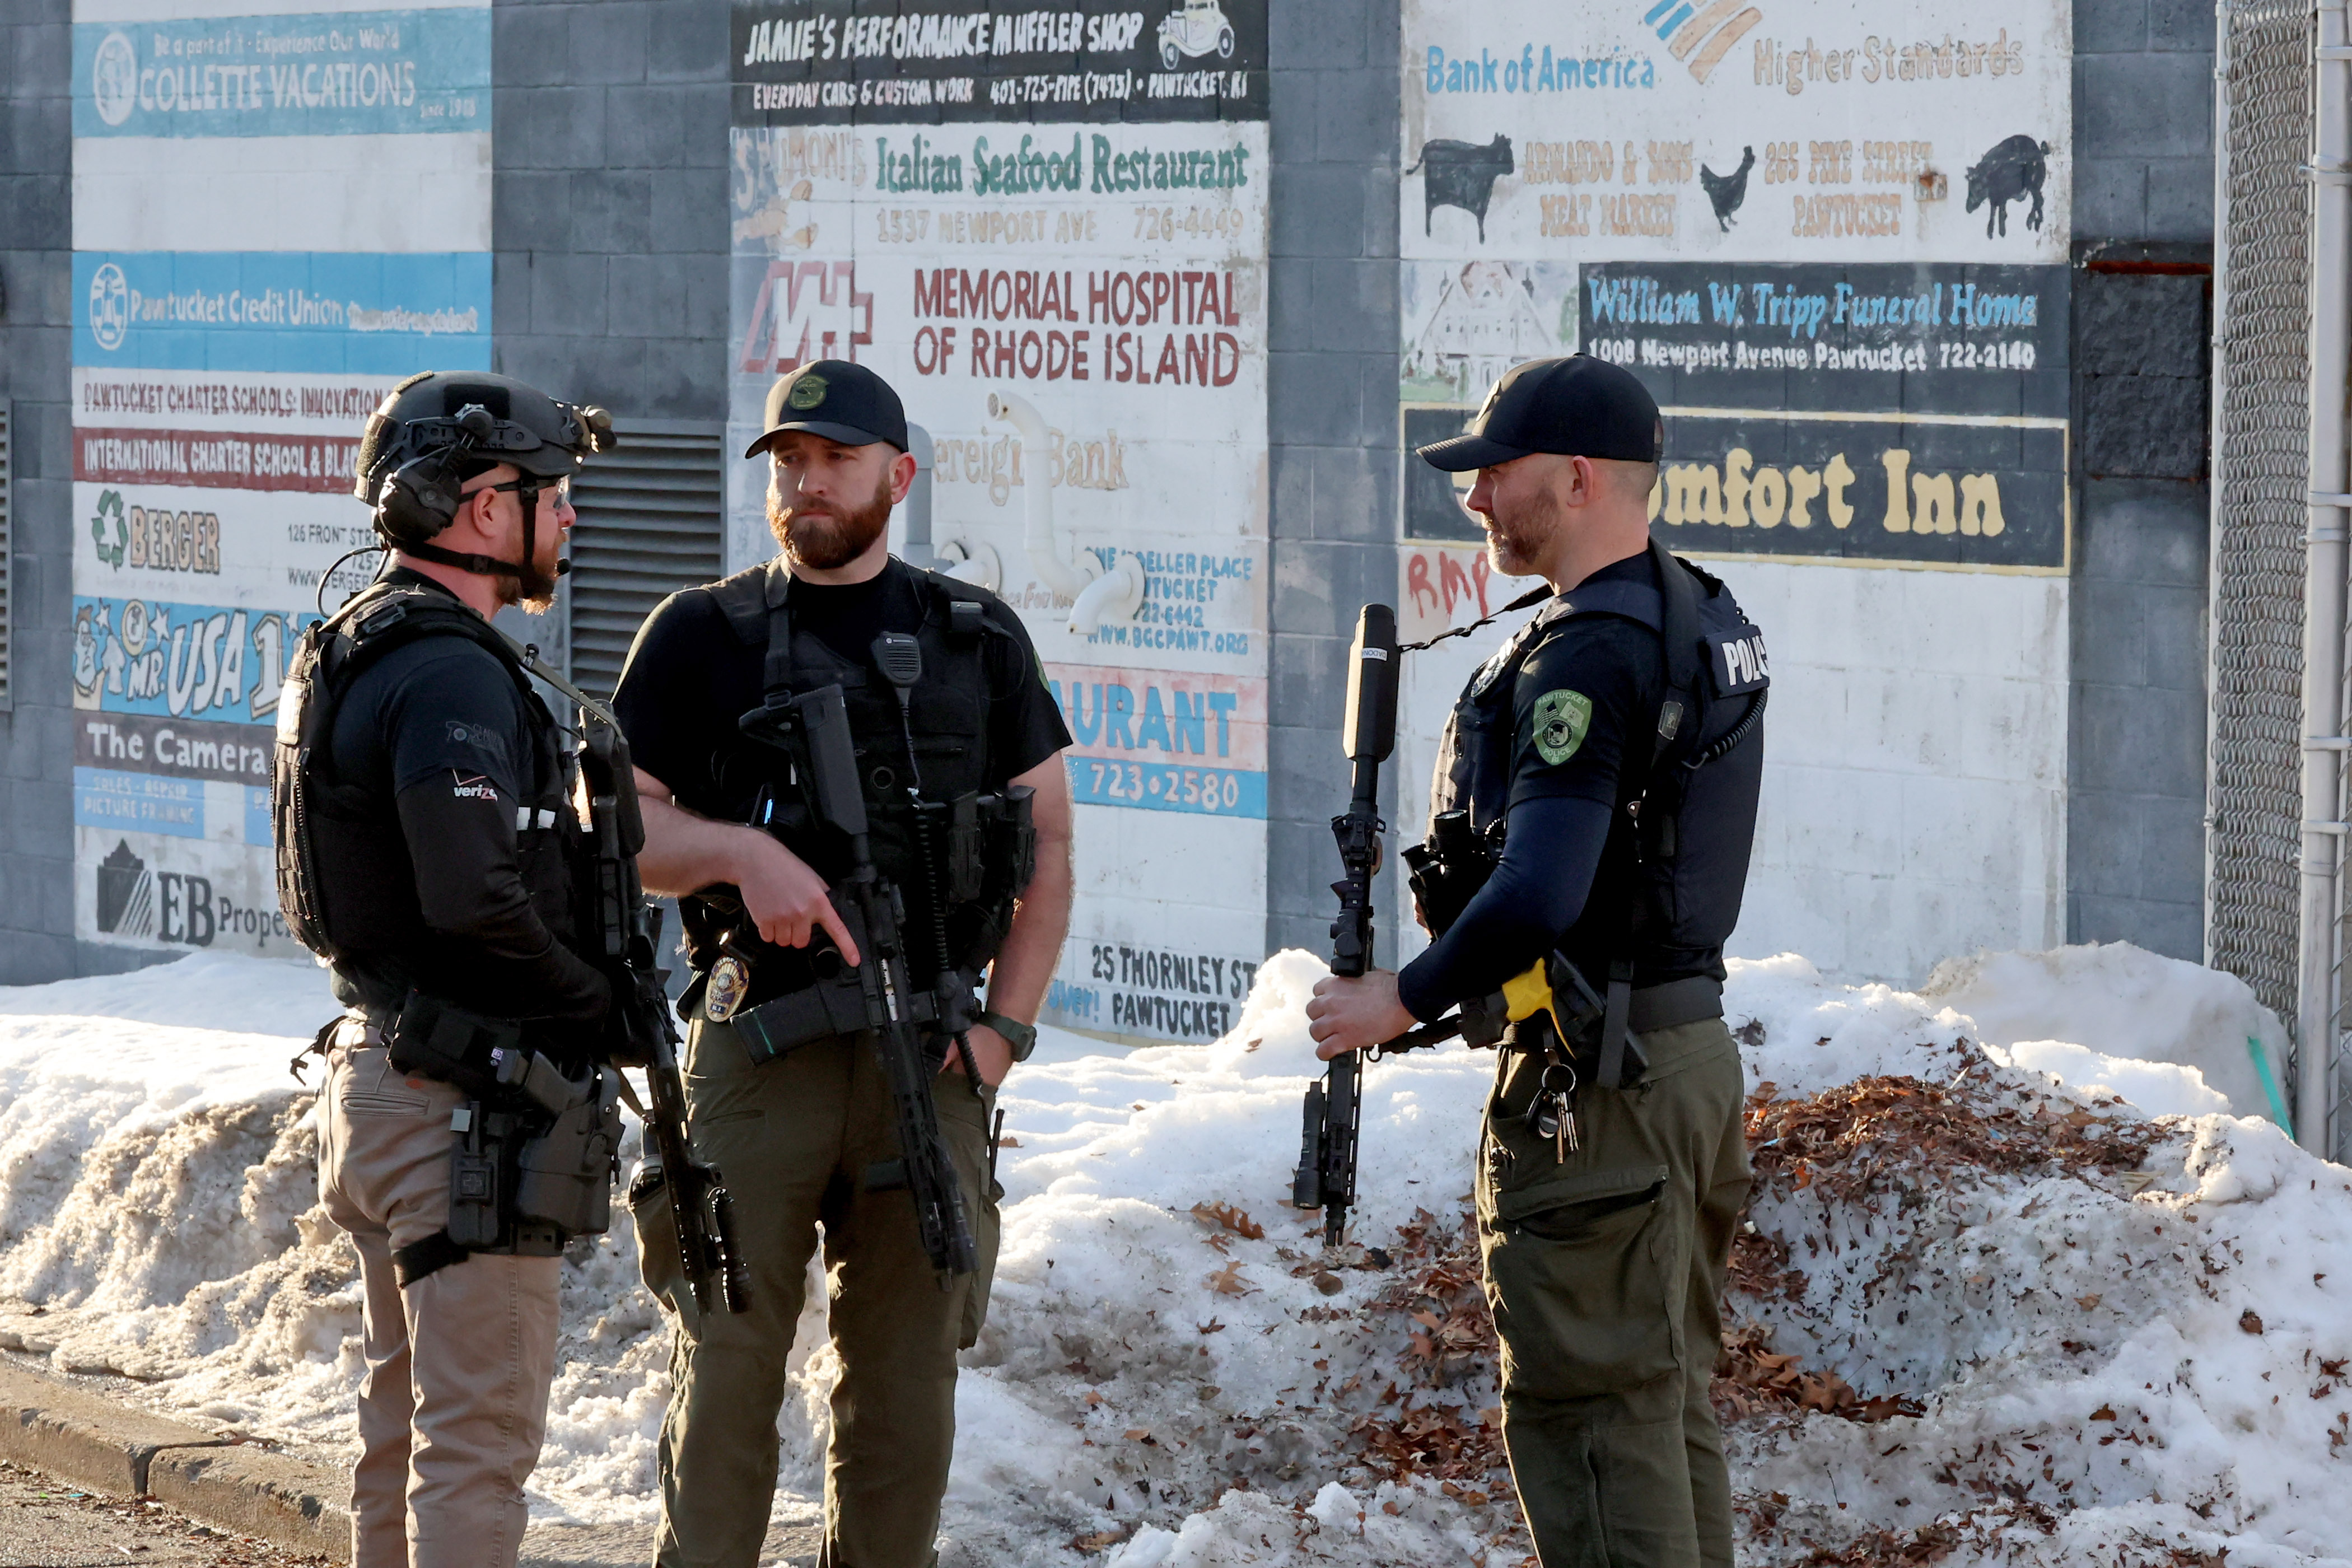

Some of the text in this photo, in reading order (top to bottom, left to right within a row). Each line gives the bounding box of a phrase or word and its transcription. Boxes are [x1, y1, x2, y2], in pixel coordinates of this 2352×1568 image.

[329, 30, 354, 52] Our
[358, 23, 400, 51] World
[744, 10, 1144, 67] JAMIE'S PERFORMANCE MUFFLER SHOP
[1427, 43, 1654, 94] Bank of America
[1754, 27, 2024, 95] Higher Standards
[139, 61, 416, 112] COLLETTE VACATIONS
[753, 77, 974, 110] EVERYDAY CARS & CUSTOM WORK
[875, 132, 1250, 196] Italian Seafood Restaurant
[1765, 140, 1933, 185] 265 PINE STREET
[876, 207, 1098, 245] 1537 NEWPORT AVE
[1133, 206, 1244, 242] 726-4449
[1540, 193, 1676, 237] MEAT MARKET
[1792, 193, 1902, 239] PAWTUCKET
[130, 288, 225, 323] Pawtucket
[229, 288, 284, 325] Credit
[288, 288, 343, 325] Union
[913, 268, 1240, 327] MEMORIAL HOSPITAL
[1587, 277, 2038, 339] William W. Tripp Funeral Home
[913, 325, 1240, 388] OF RHODE ISLAND
[1588, 337, 1636, 365] 1008
[1641, 338, 1730, 376] Newport
[1734, 340, 1809, 371] Avenue
[1814, 340, 1927, 372] Pawtucket
[84, 382, 164, 414] PAWTUCKET
[168, 384, 228, 416] CHARTER
[232, 385, 296, 417] SCHOOLS:
[84, 438, 361, 479] INTERNATIONAL CHARTER SCHOOL & BLAC
[1044, 426, 1129, 491] Bank
[1647, 448, 2006, 538] mfort Inn
[130, 505, 220, 575] BERGER
[288, 524, 379, 548] 126 FRONT STRE
[1085, 546, 1117, 571] NE
[1201, 554, 1253, 581] PLACE
[127, 648, 165, 702] MR.
[168, 609, 247, 717] USA
[1721, 635, 1770, 687] POLIC
[1537, 692, 1588, 707] PAWTUCKET
[87, 722, 267, 776] The Camera
[1543, 746, 1571, 757] POLICE
[84, 796, 137, 819] PICTURE
[93, 776, 132, 795] SALES
[454, 783, 498, 802] verizo
[157, 870, 216, 948] EB
[1092, 945, 1257, 1000] 25 THORNLEY ST
[1112, 992, 1230, 1038] PAWTUCKET
